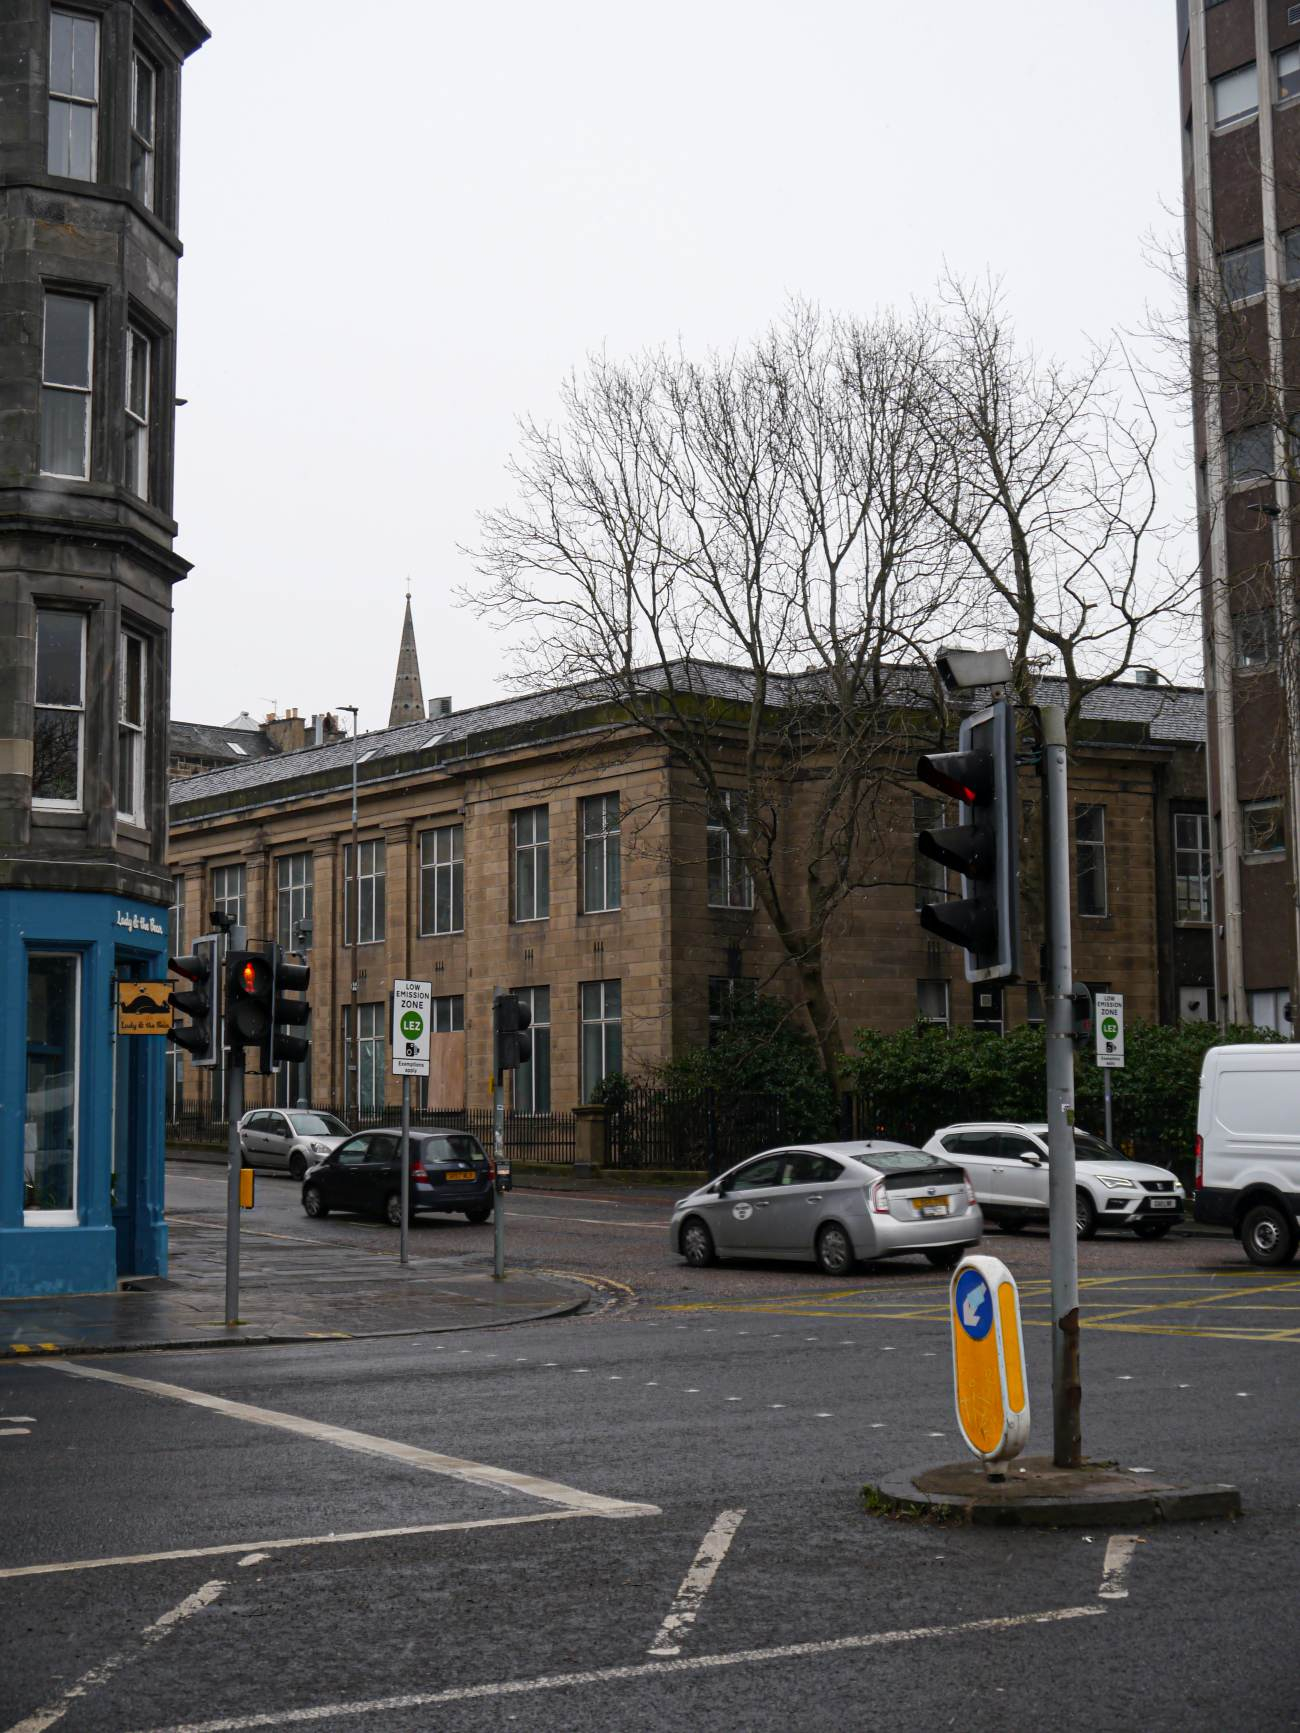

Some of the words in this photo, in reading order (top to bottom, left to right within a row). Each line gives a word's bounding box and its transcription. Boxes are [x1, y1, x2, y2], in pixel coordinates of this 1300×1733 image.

[117, 910, 133, 933] Lady
[133, 914, 140, 929] &
[140, 916, 150, 931] the
[396, 990, 430, 999] EMISSION
[401, 1000, 424, 1010] ZONE
[1101, 1008, 1119, 1016] ZONE
[121, 1021, 137, 1031] Lady
[403, 1020, 421, 1031] LEZ
[1103, 1024, 1118, 1033] LEZ
